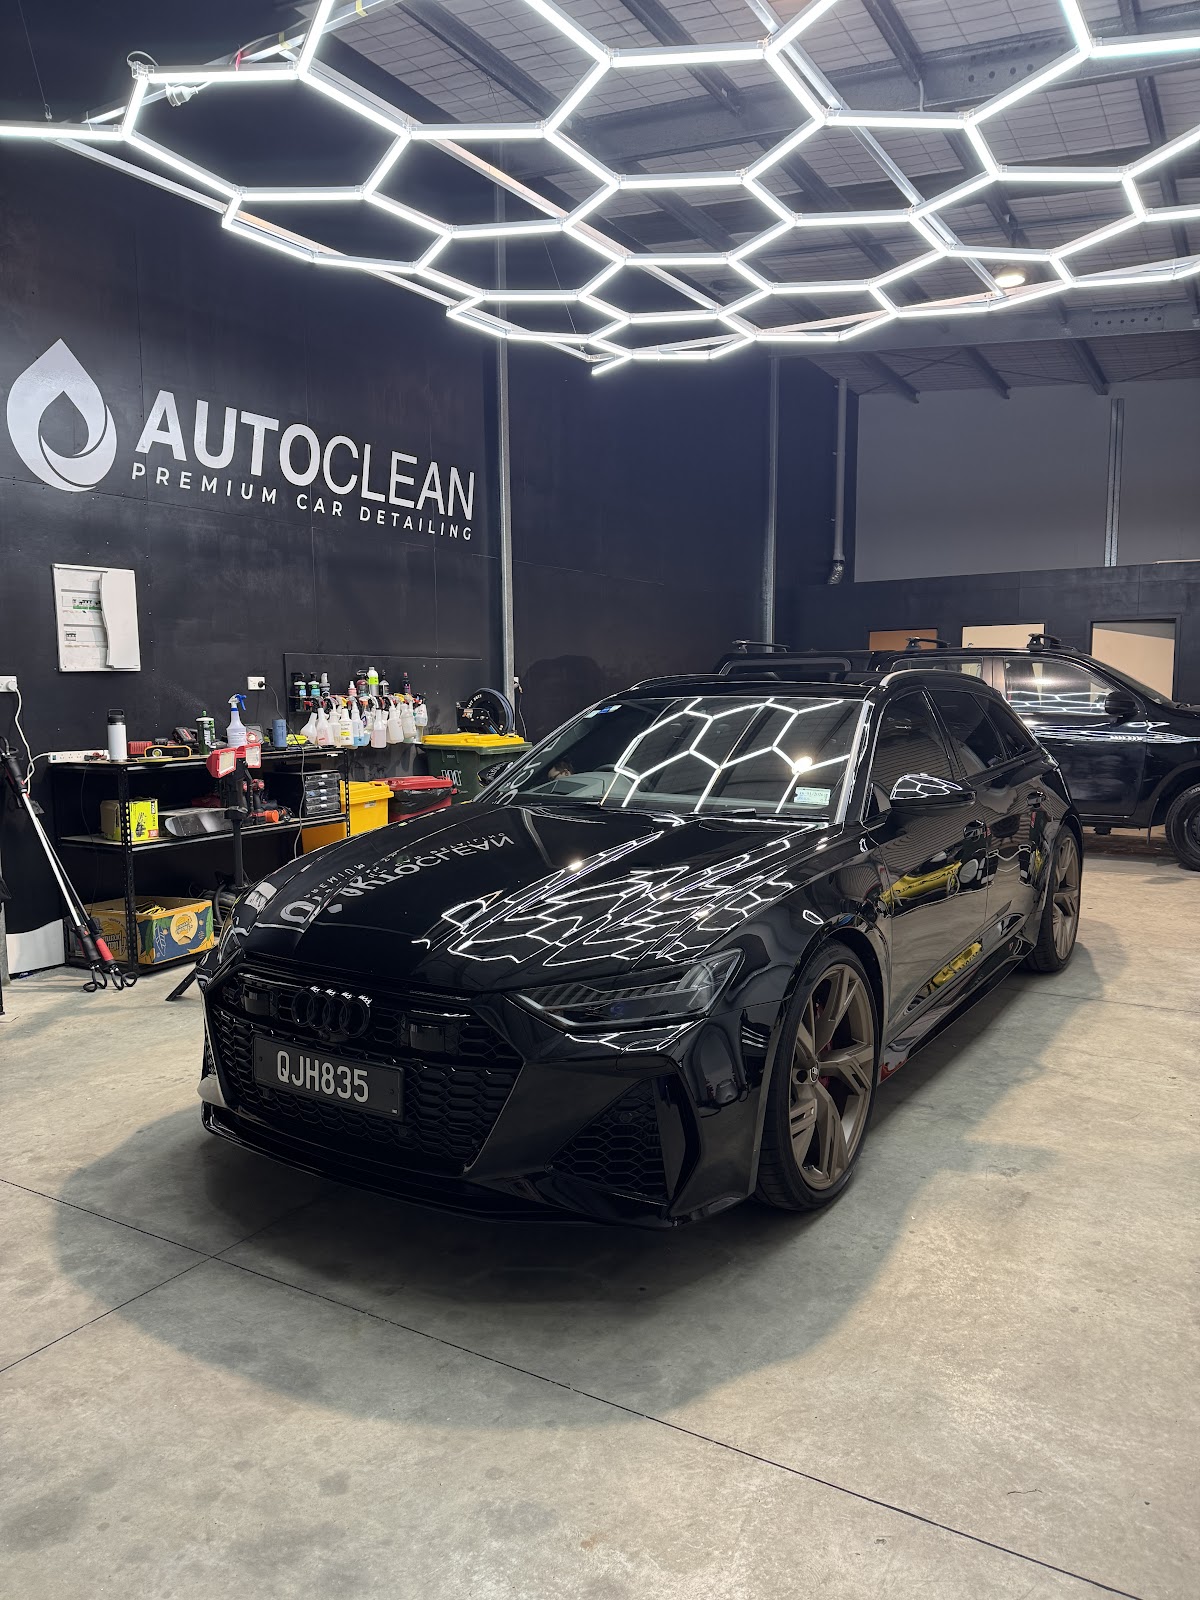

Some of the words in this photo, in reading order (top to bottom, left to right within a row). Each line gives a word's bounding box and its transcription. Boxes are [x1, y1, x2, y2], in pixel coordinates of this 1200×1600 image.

[134, 390, 475, 520] AUTOCLEAN
[131, 462, 277, 505] PREMIUM
[296, 494, 343, 517] CAR
[359, 506, 473, 541] DETAILING
[276, 1050, 369, 1103] QJH835
